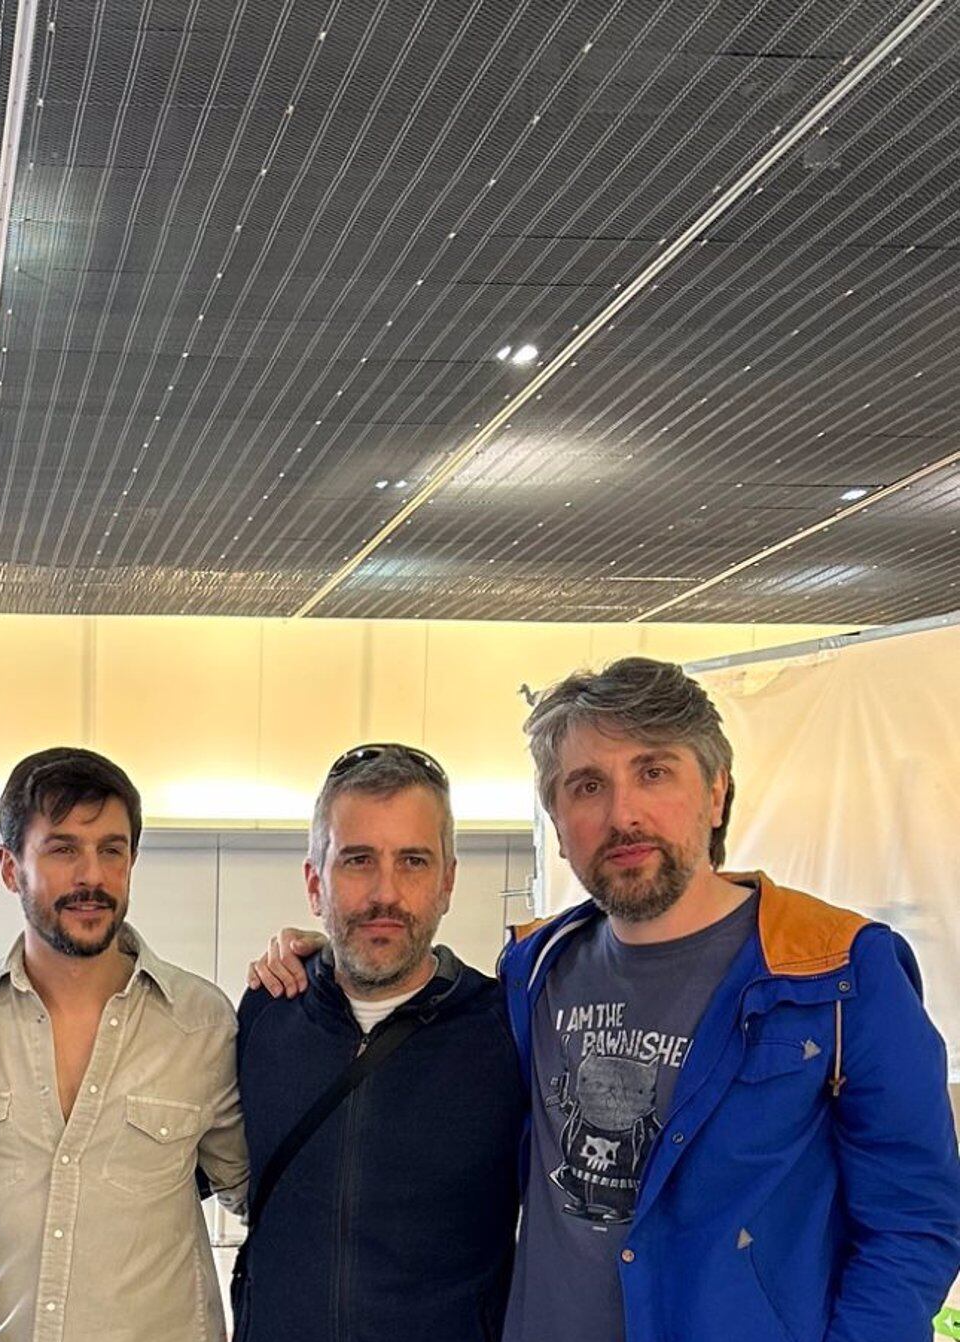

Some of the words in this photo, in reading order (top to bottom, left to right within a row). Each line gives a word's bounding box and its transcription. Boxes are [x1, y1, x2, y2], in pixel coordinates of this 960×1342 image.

[556, 1009, 564, 1031] I
[566, 1004, 594, 1032] AM
[596, 1002, 626, 1028] THE
[581, 1029, 694, 1069] PAWNISHE
